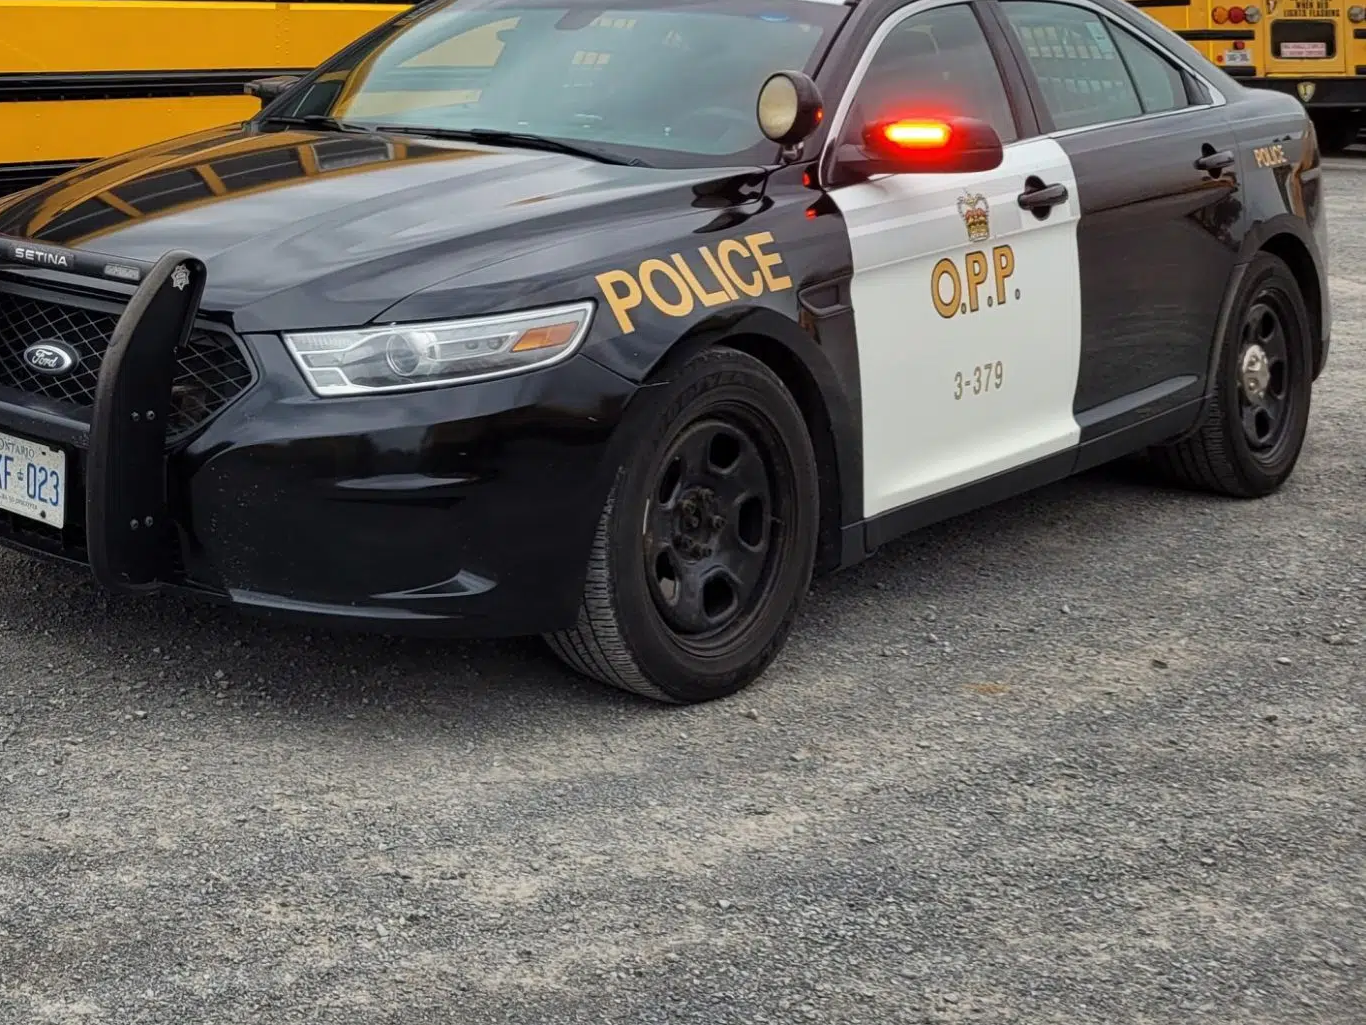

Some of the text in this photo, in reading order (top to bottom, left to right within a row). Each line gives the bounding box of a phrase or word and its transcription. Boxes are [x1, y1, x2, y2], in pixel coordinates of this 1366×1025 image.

[1254, 144, 1287, 168] POLICE
[15, 247, 68, 266] SETINA
[595, 231, 793, 335] POLICE
[931, 244, 1021, 318] O.P.P.
[32, 349, 59, 367] Ford
[954, 360, 1003, 400] 3-379
